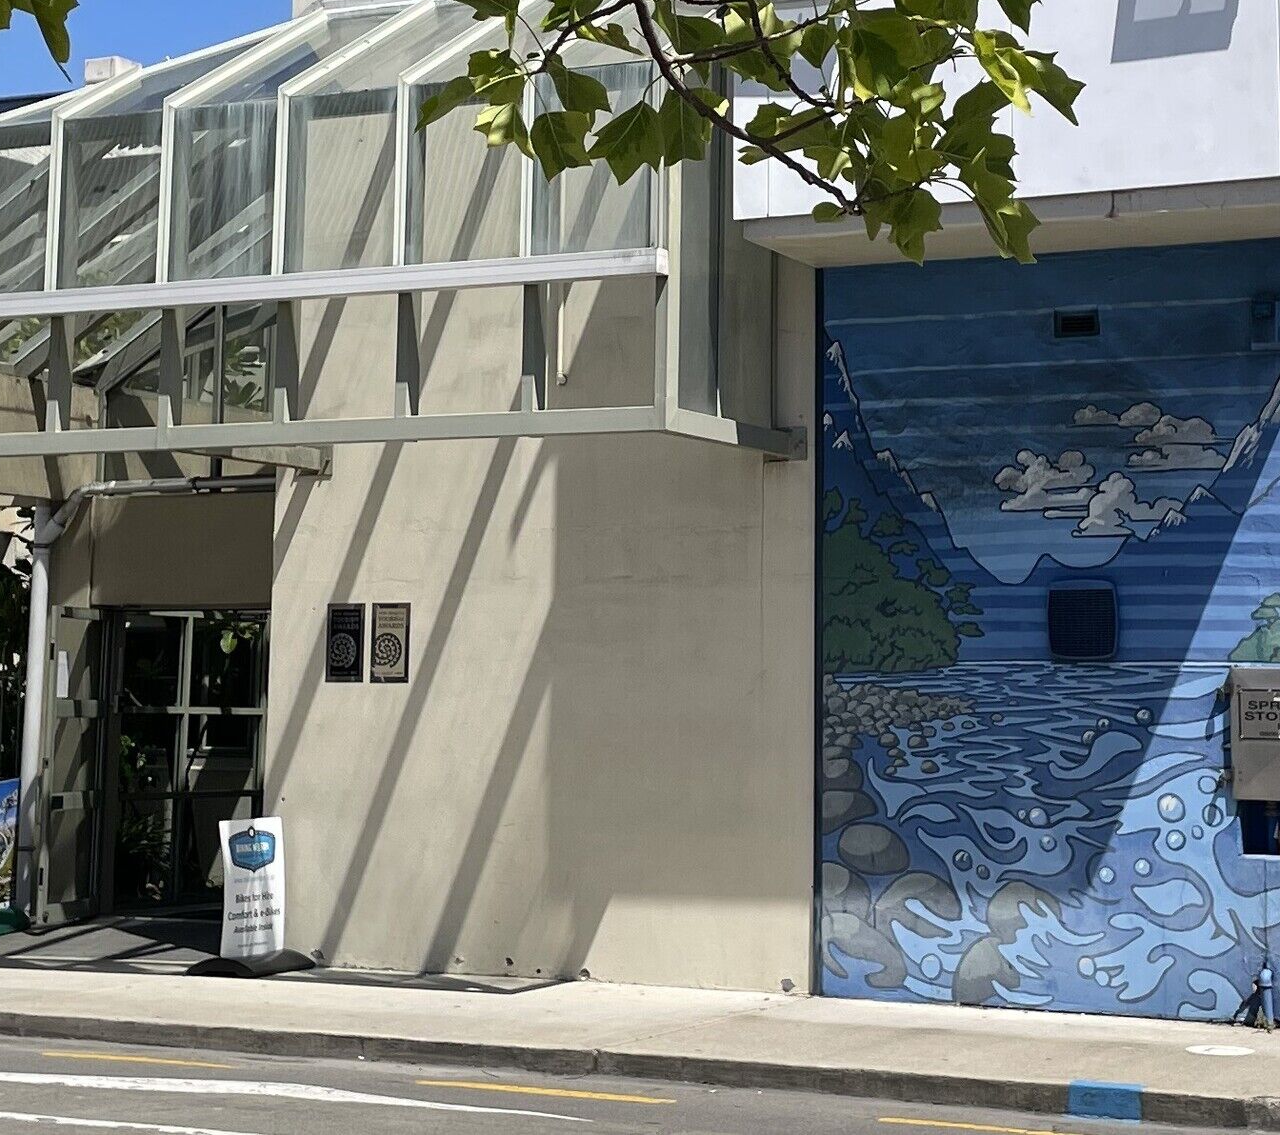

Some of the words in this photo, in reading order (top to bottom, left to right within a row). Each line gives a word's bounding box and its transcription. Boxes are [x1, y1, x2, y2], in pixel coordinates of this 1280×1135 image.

[235, 893, 251, 904] Bikes
[227, 910, 253, 922] Comfort
[253, 909, 259, 918] &
